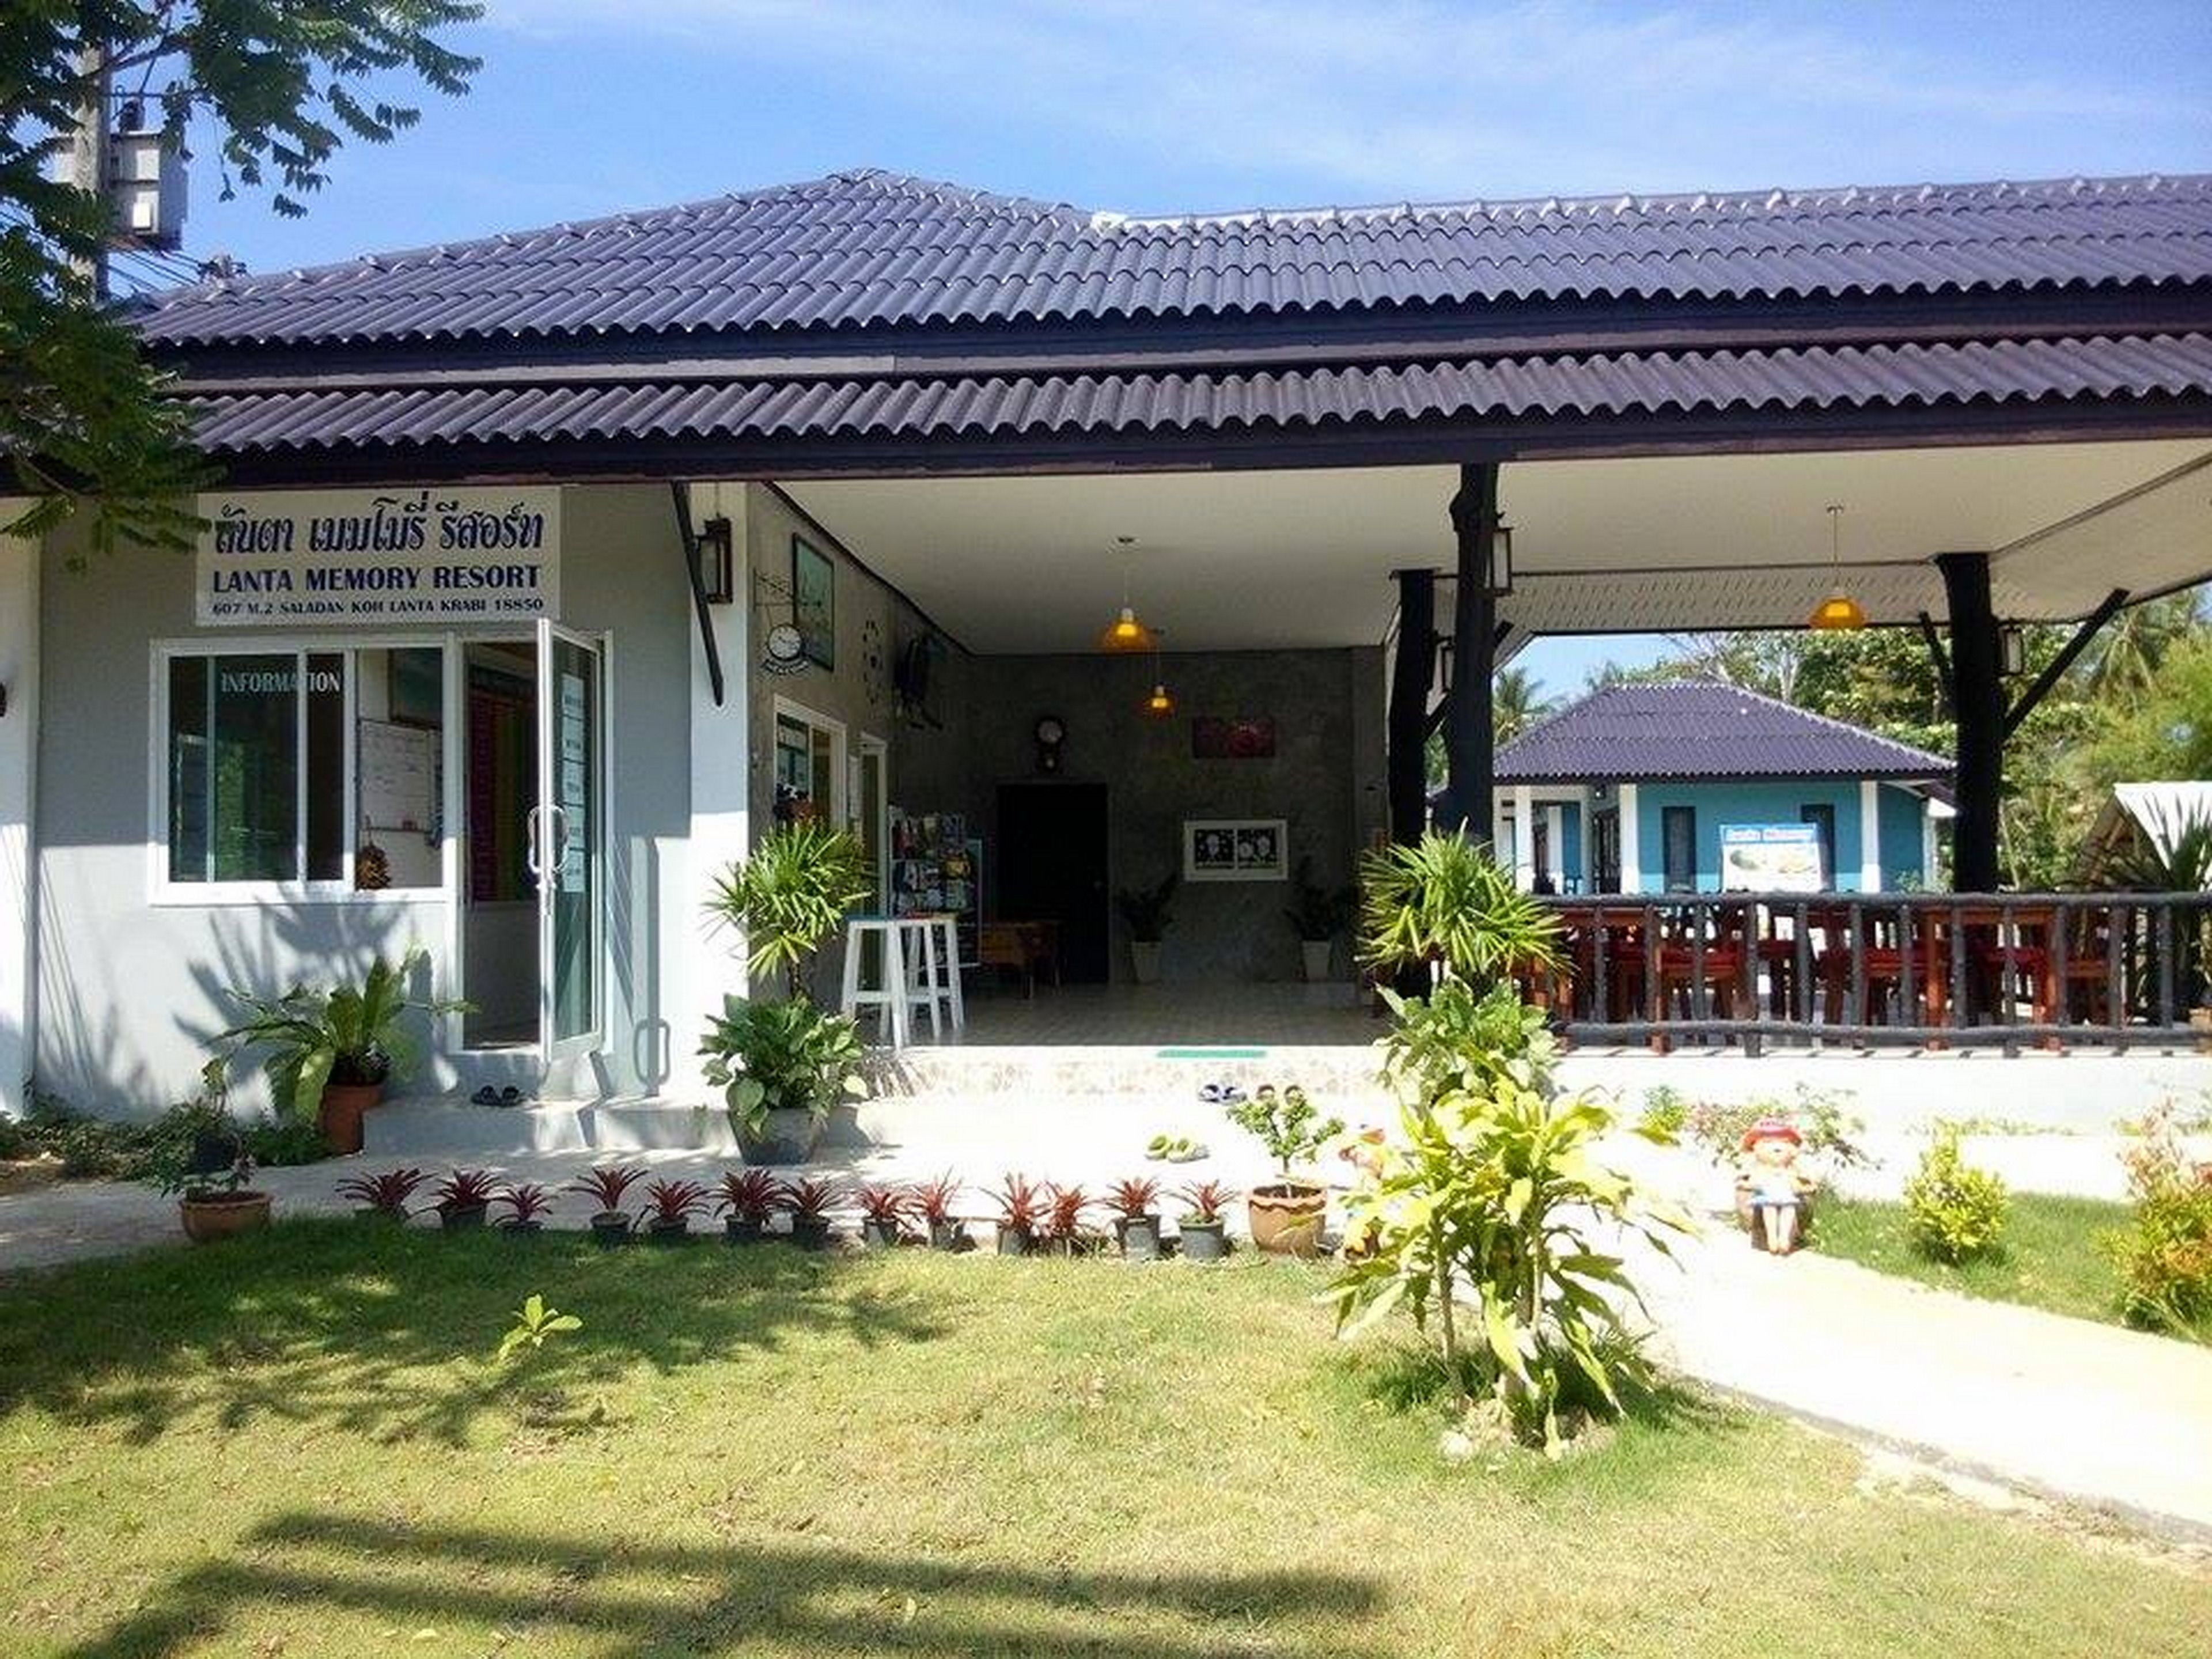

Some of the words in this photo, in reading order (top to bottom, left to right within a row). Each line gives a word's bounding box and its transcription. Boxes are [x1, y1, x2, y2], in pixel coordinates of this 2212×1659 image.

[214, 570, 293, 592] LANTA
[306, 566, 421, 590] MEMORY
[433, 565, 540, 589] RESORT
[390, 600, 434, 613] LANTA
[441, 599, 487, 612] KRABI
[221, 672, 343, 692] INFORMAION
